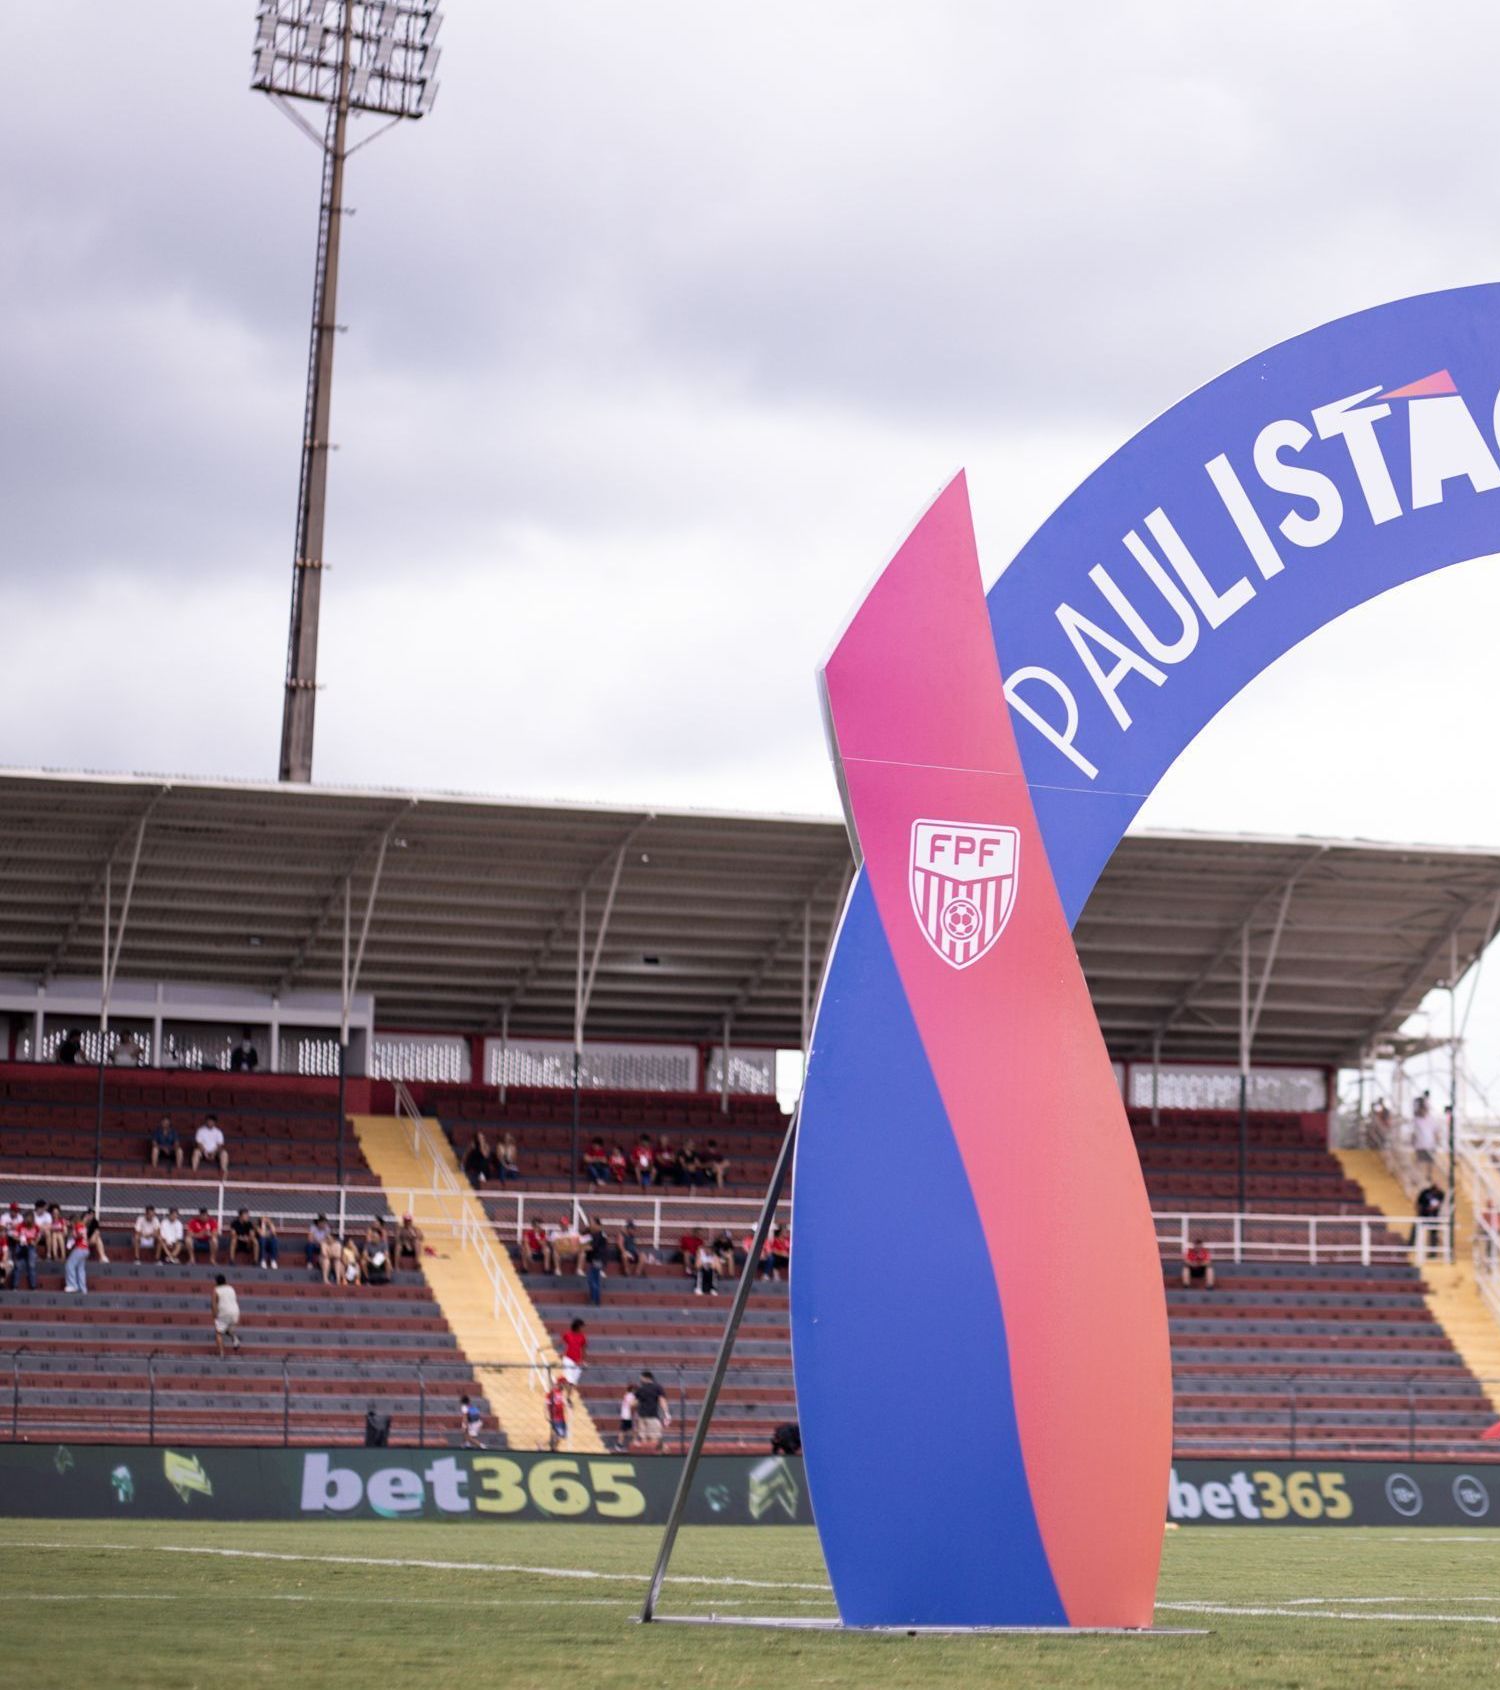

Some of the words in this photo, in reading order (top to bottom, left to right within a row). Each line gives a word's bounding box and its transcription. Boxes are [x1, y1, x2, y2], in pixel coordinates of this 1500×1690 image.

[929, 833, 1001, 867] FPF
[300, 1453, 647, 1518] bet365
[1168, 1468, 1354, 1520] bet365
